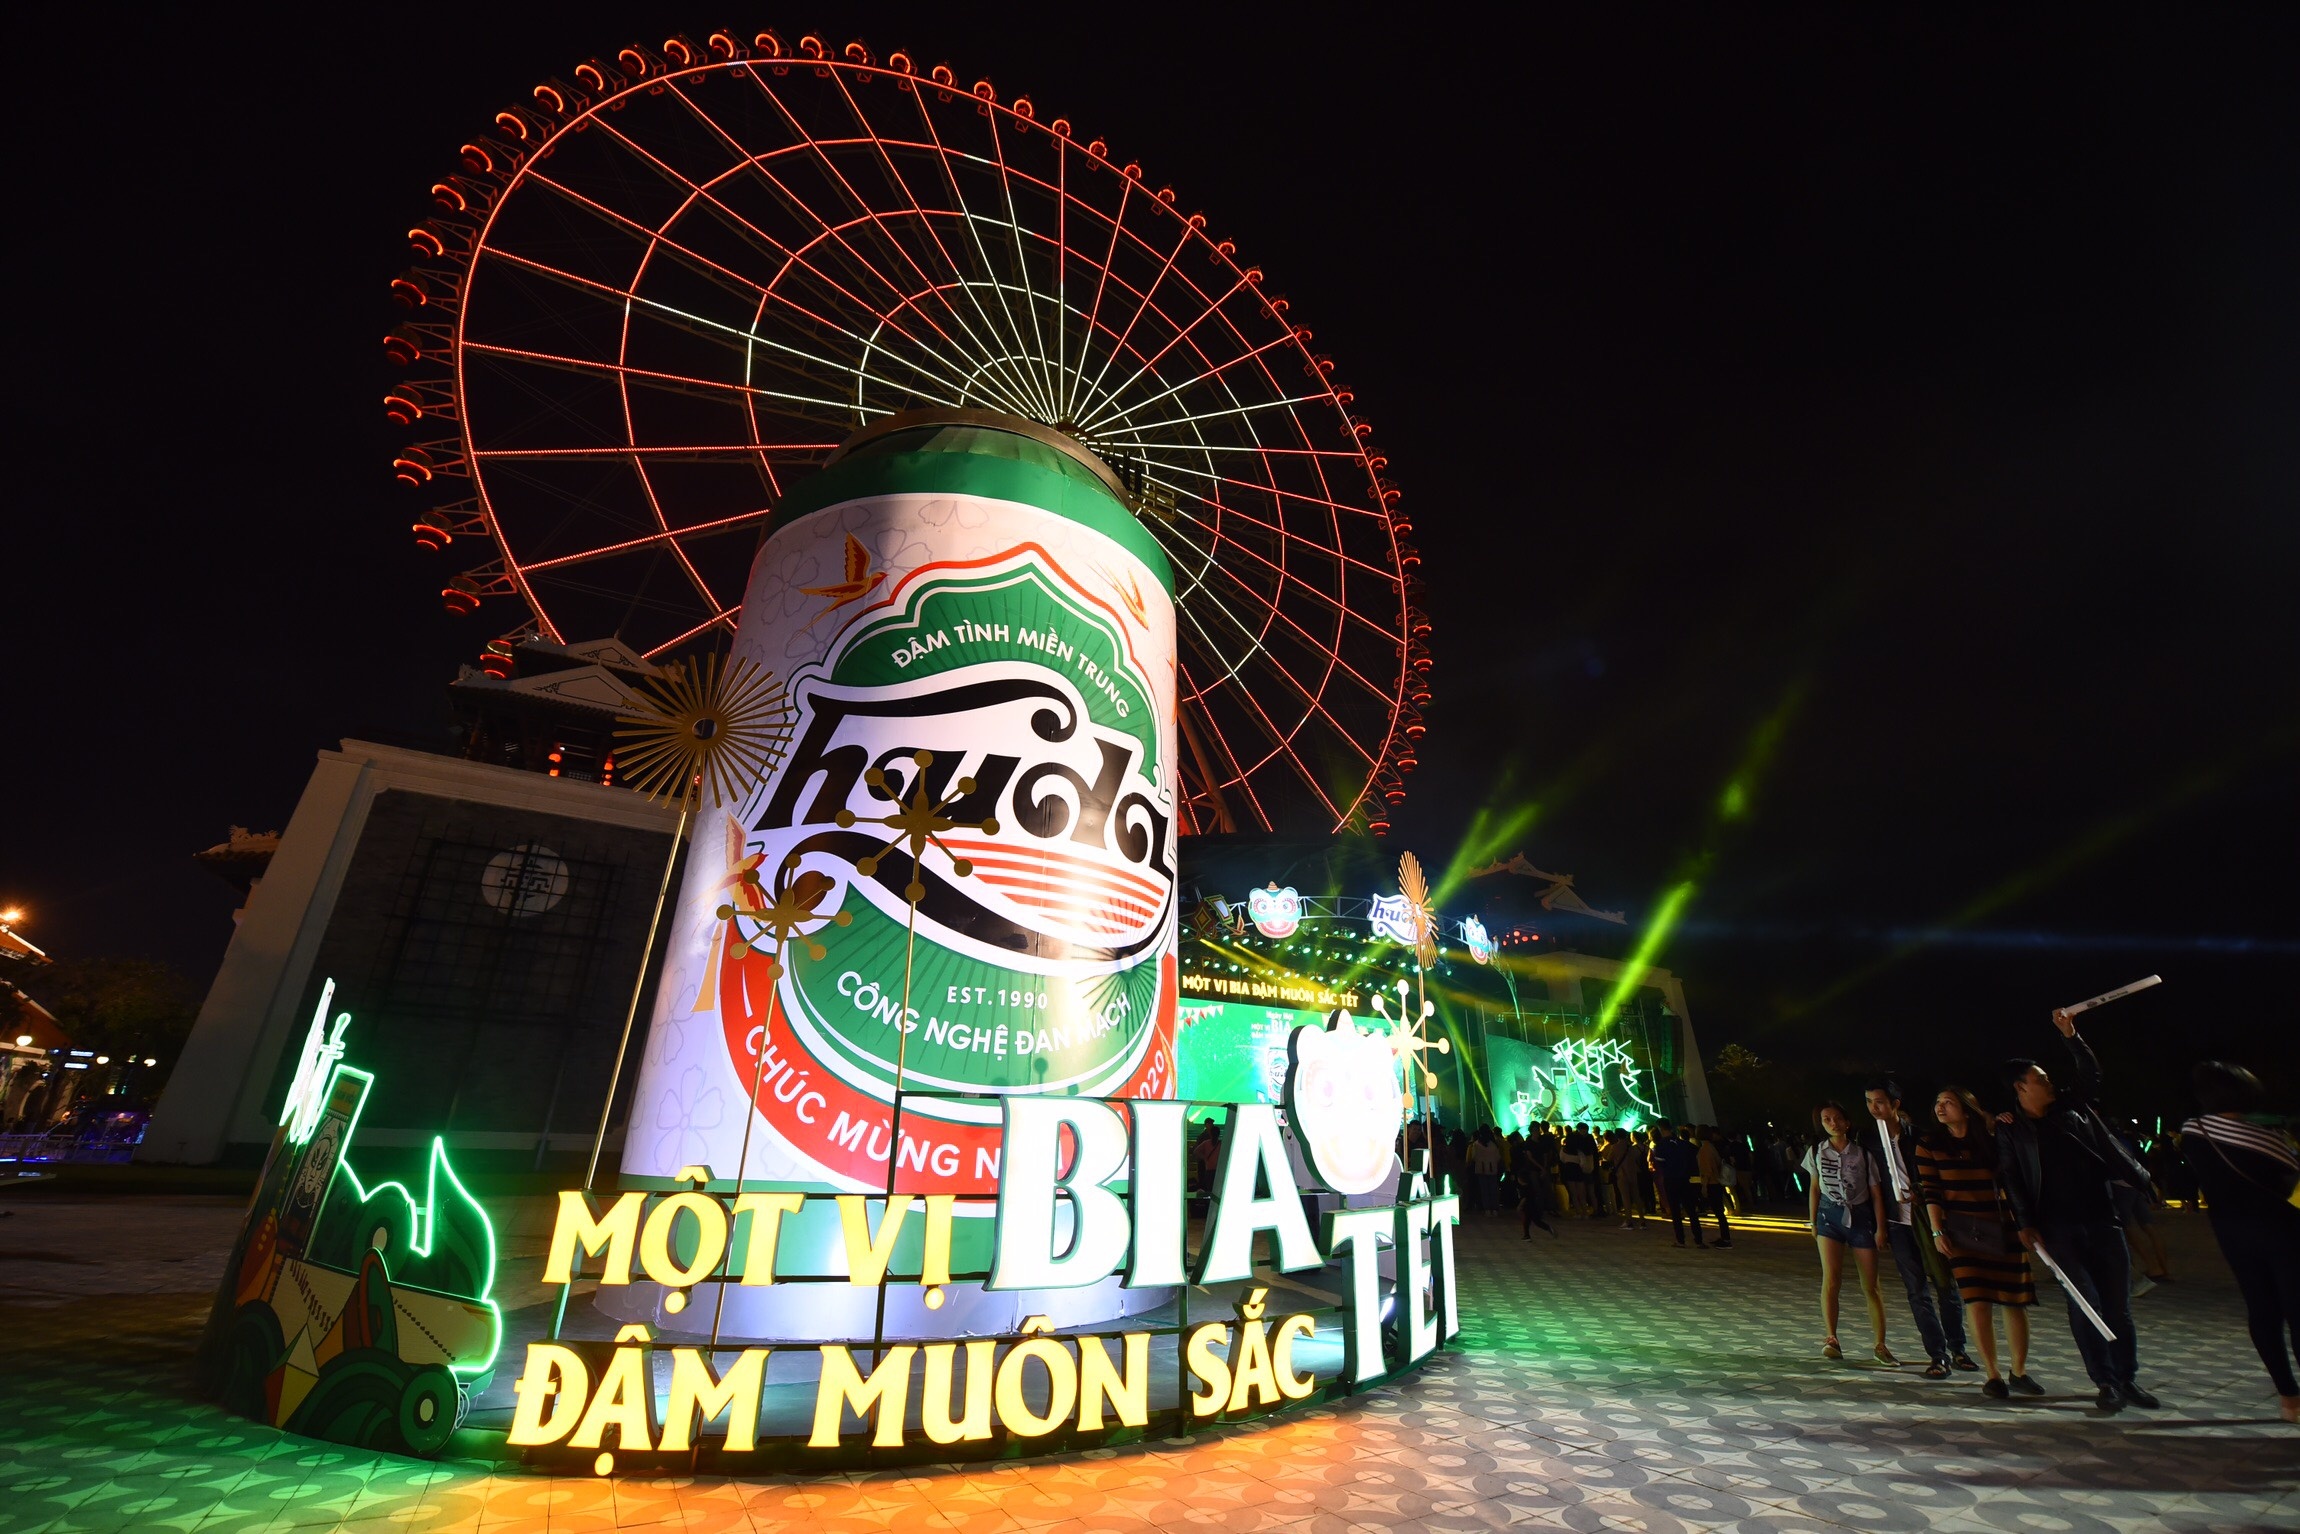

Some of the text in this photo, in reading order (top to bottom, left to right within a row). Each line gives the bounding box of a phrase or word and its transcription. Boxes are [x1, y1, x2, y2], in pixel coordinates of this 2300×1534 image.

[891, 619, 1130, 718] ĐẬM TÌNH MIỀN TRUNG
[837, 971, 1132, 1061] CÔNG NGHỆ ĐAN MẠCH
[1182, 975, 1211, 992] MỘT
[1213, 979, 1227, 995] VỊ
[1229, 981, 1250, 995] BIA
[1252, 982, 1278, 999] ĐẬM
[1281, 986, 1314, 1003] MUÔN
[1318, 988, 1337, 1005] SẮC
[745, 1025, 960, 1178] CHÚC MỪNG
[541, 1095, 1325, 1314] MỘT VỊ BIA
[506, 1148, 1461, 1476] ĐẬM MUÔN SẮC TẾT
